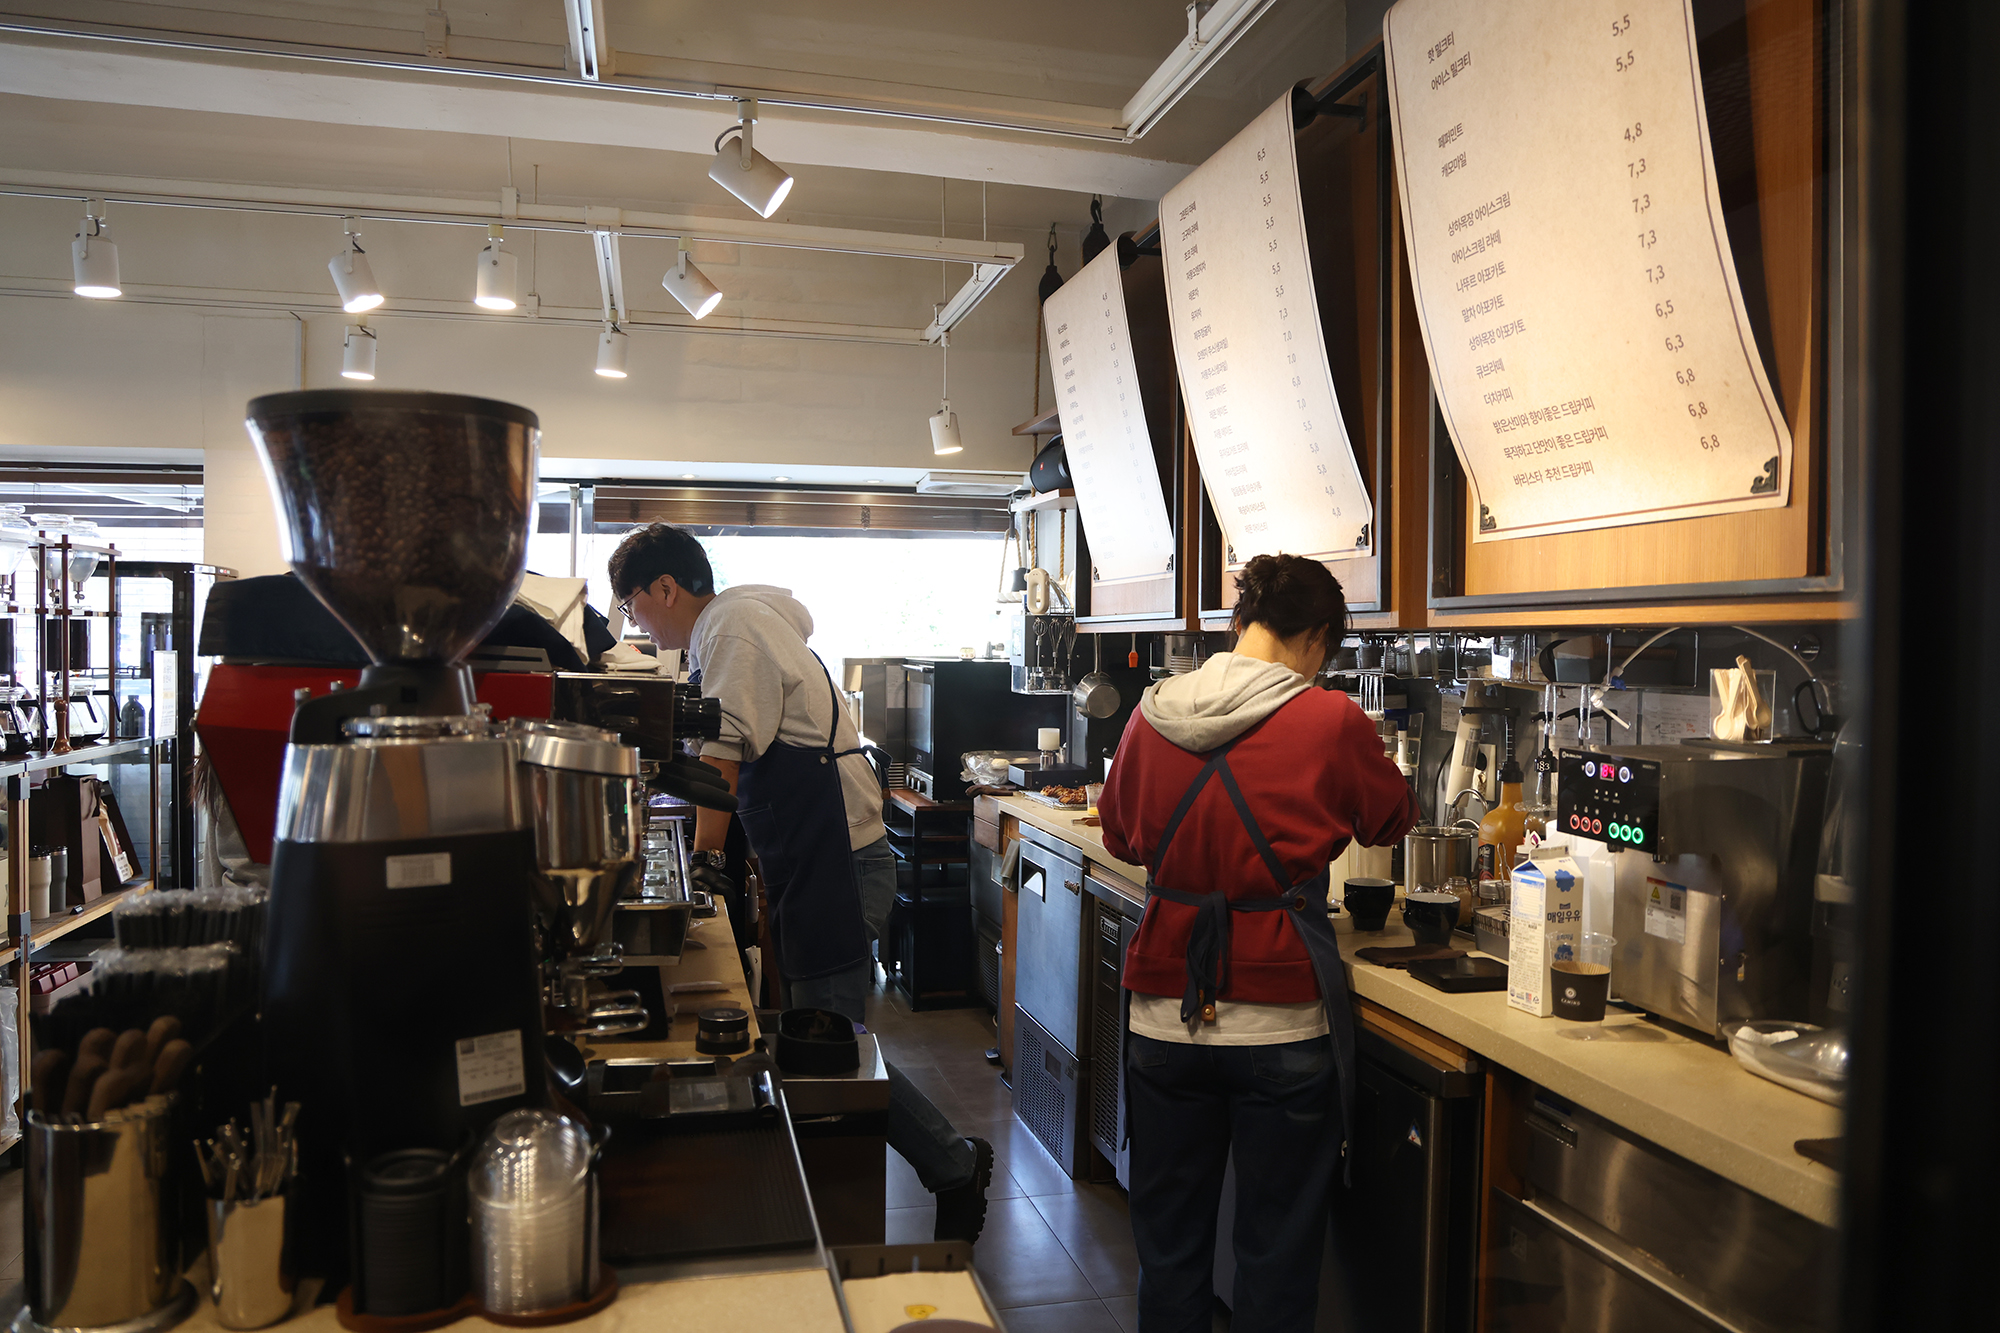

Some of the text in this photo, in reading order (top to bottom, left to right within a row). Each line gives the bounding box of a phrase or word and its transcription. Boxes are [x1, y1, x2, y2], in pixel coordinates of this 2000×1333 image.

[1612, 14, 1630, 36] 5,5
[1435, 31, 1455, 58] 밀크티
[1431, 51, 1471, 90] 아이스 밀크티
[1616, 50, 1634, 72] 5,5
[1438, 122, 1464, 148] 페퍼민트
[1624, 122, 1643, 143] 4,8
[1627, 158, 1646, 179] 7,3
[1448, 191, 1511, 237] 상하목장 아이스크림
[1632, 194, 1651, 214] 7,3
[1451, 229, 1502, 264] 아이스크림 라떼
[1638, 229, 1657, 250] 7,3
[1477, 261, 1506, 284] 아포카토
[1646, 264, 1665, 284] 7,3
[1461, 294, 1505, 323] 말차 아포카토
[1655, 299, 1674, 319] 6,5
[1469, 319, 1526, 351] 상하목장 아포카토
[1665, 334, 1684, 353] 6,3
[1676, 367, 1695, 386] 6,8
[1483, 387, 1514, 406] 더치커피
[1561, 395, 1595, 416] 드립커피
[1688, 401, 1708, 419] 6,8
[1555, 433, 1575, 450] 좋은
[1574, 425, 1609, 444] 드립커피
[1700, 434, 1720, 452] 6,8
[1513, 460, 1595, 487] 바리스타 추천 드립커피
[1601, 764, 1615, 779] 84
[1547, 910, 1581, 923] 매일우유
